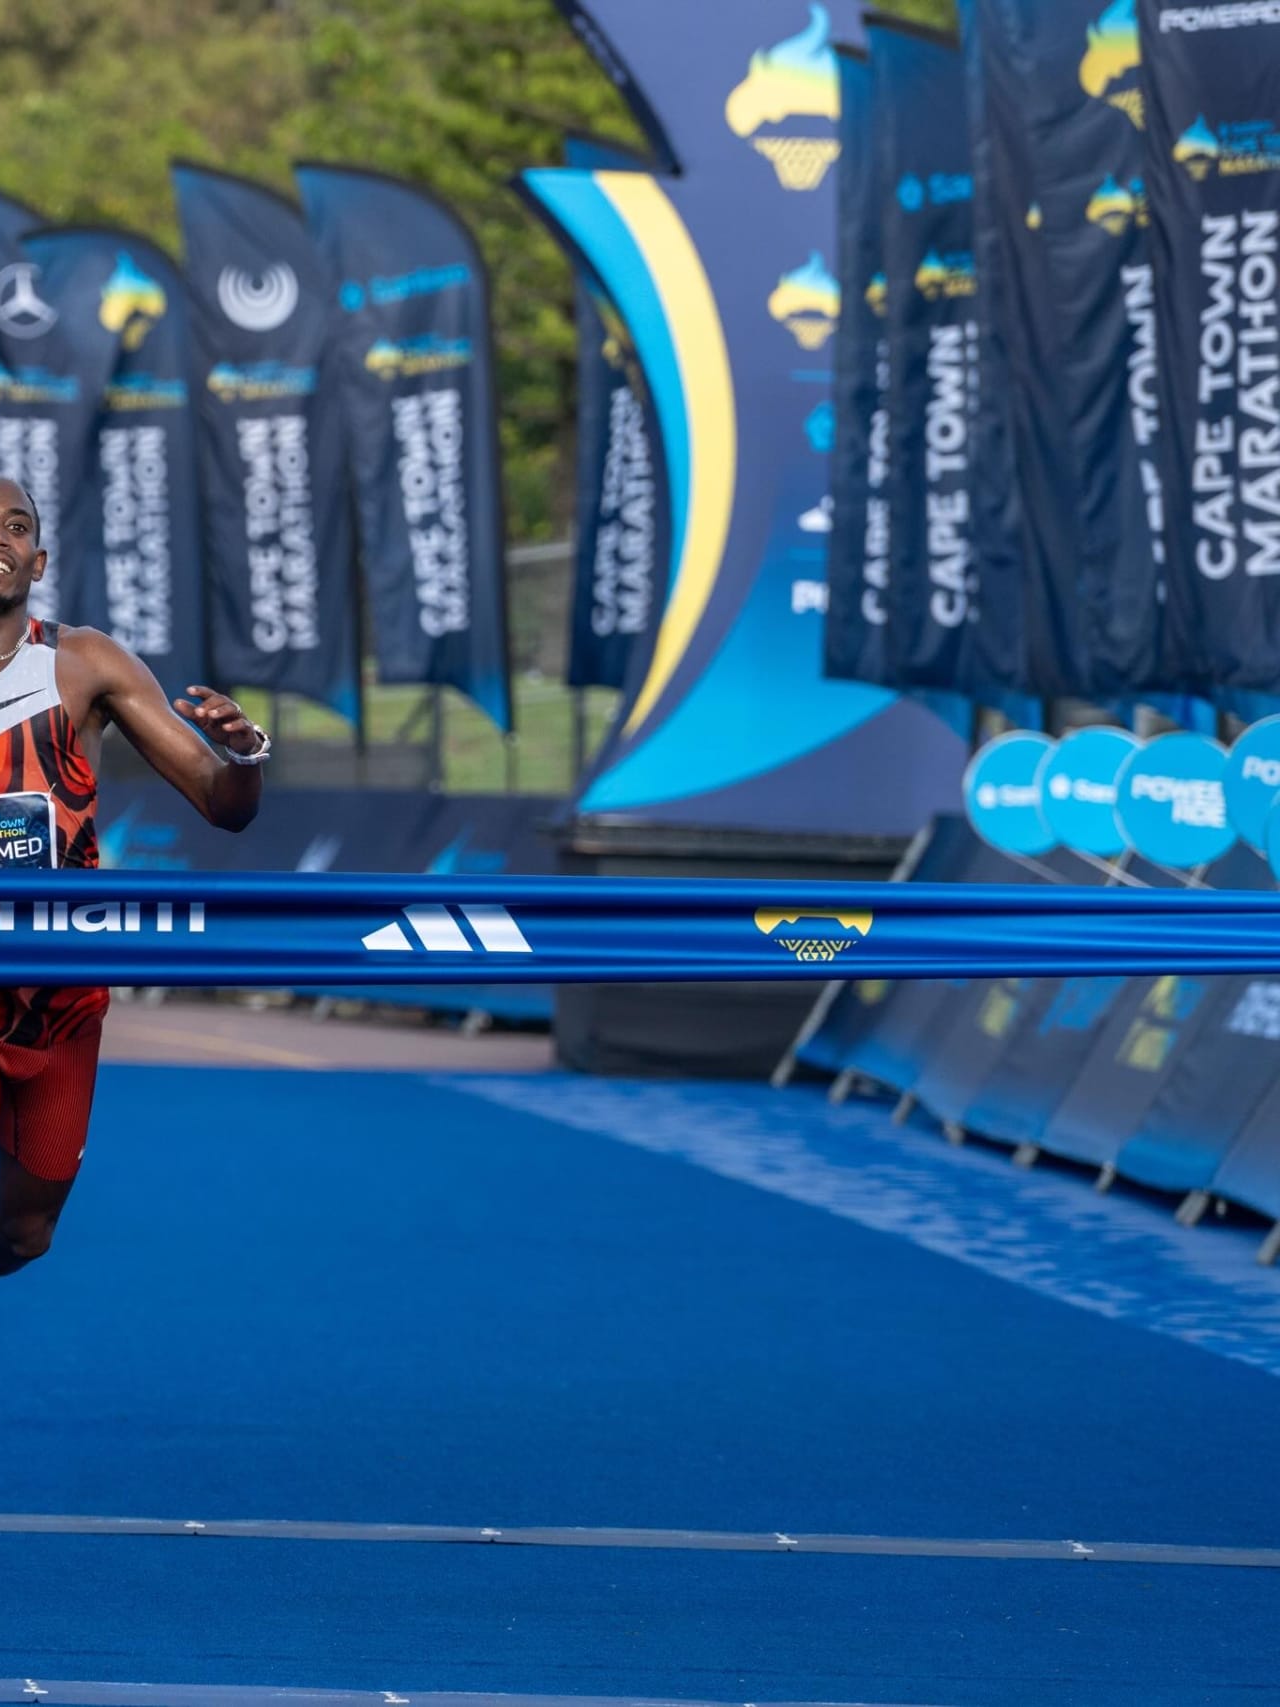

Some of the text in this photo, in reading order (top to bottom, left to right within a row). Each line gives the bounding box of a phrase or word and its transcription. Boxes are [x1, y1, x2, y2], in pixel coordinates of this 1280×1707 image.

[925, 324, 967, 482] TOWN
[1195, 213, 1237, 580] CAPE TOWN
[1237, 210, 1280, 577] MARATHON
[235, 418, 282, 540] TOWN
[247, 545, 287, 652] CAPE
[926, 489, 969, 627] CAPE
